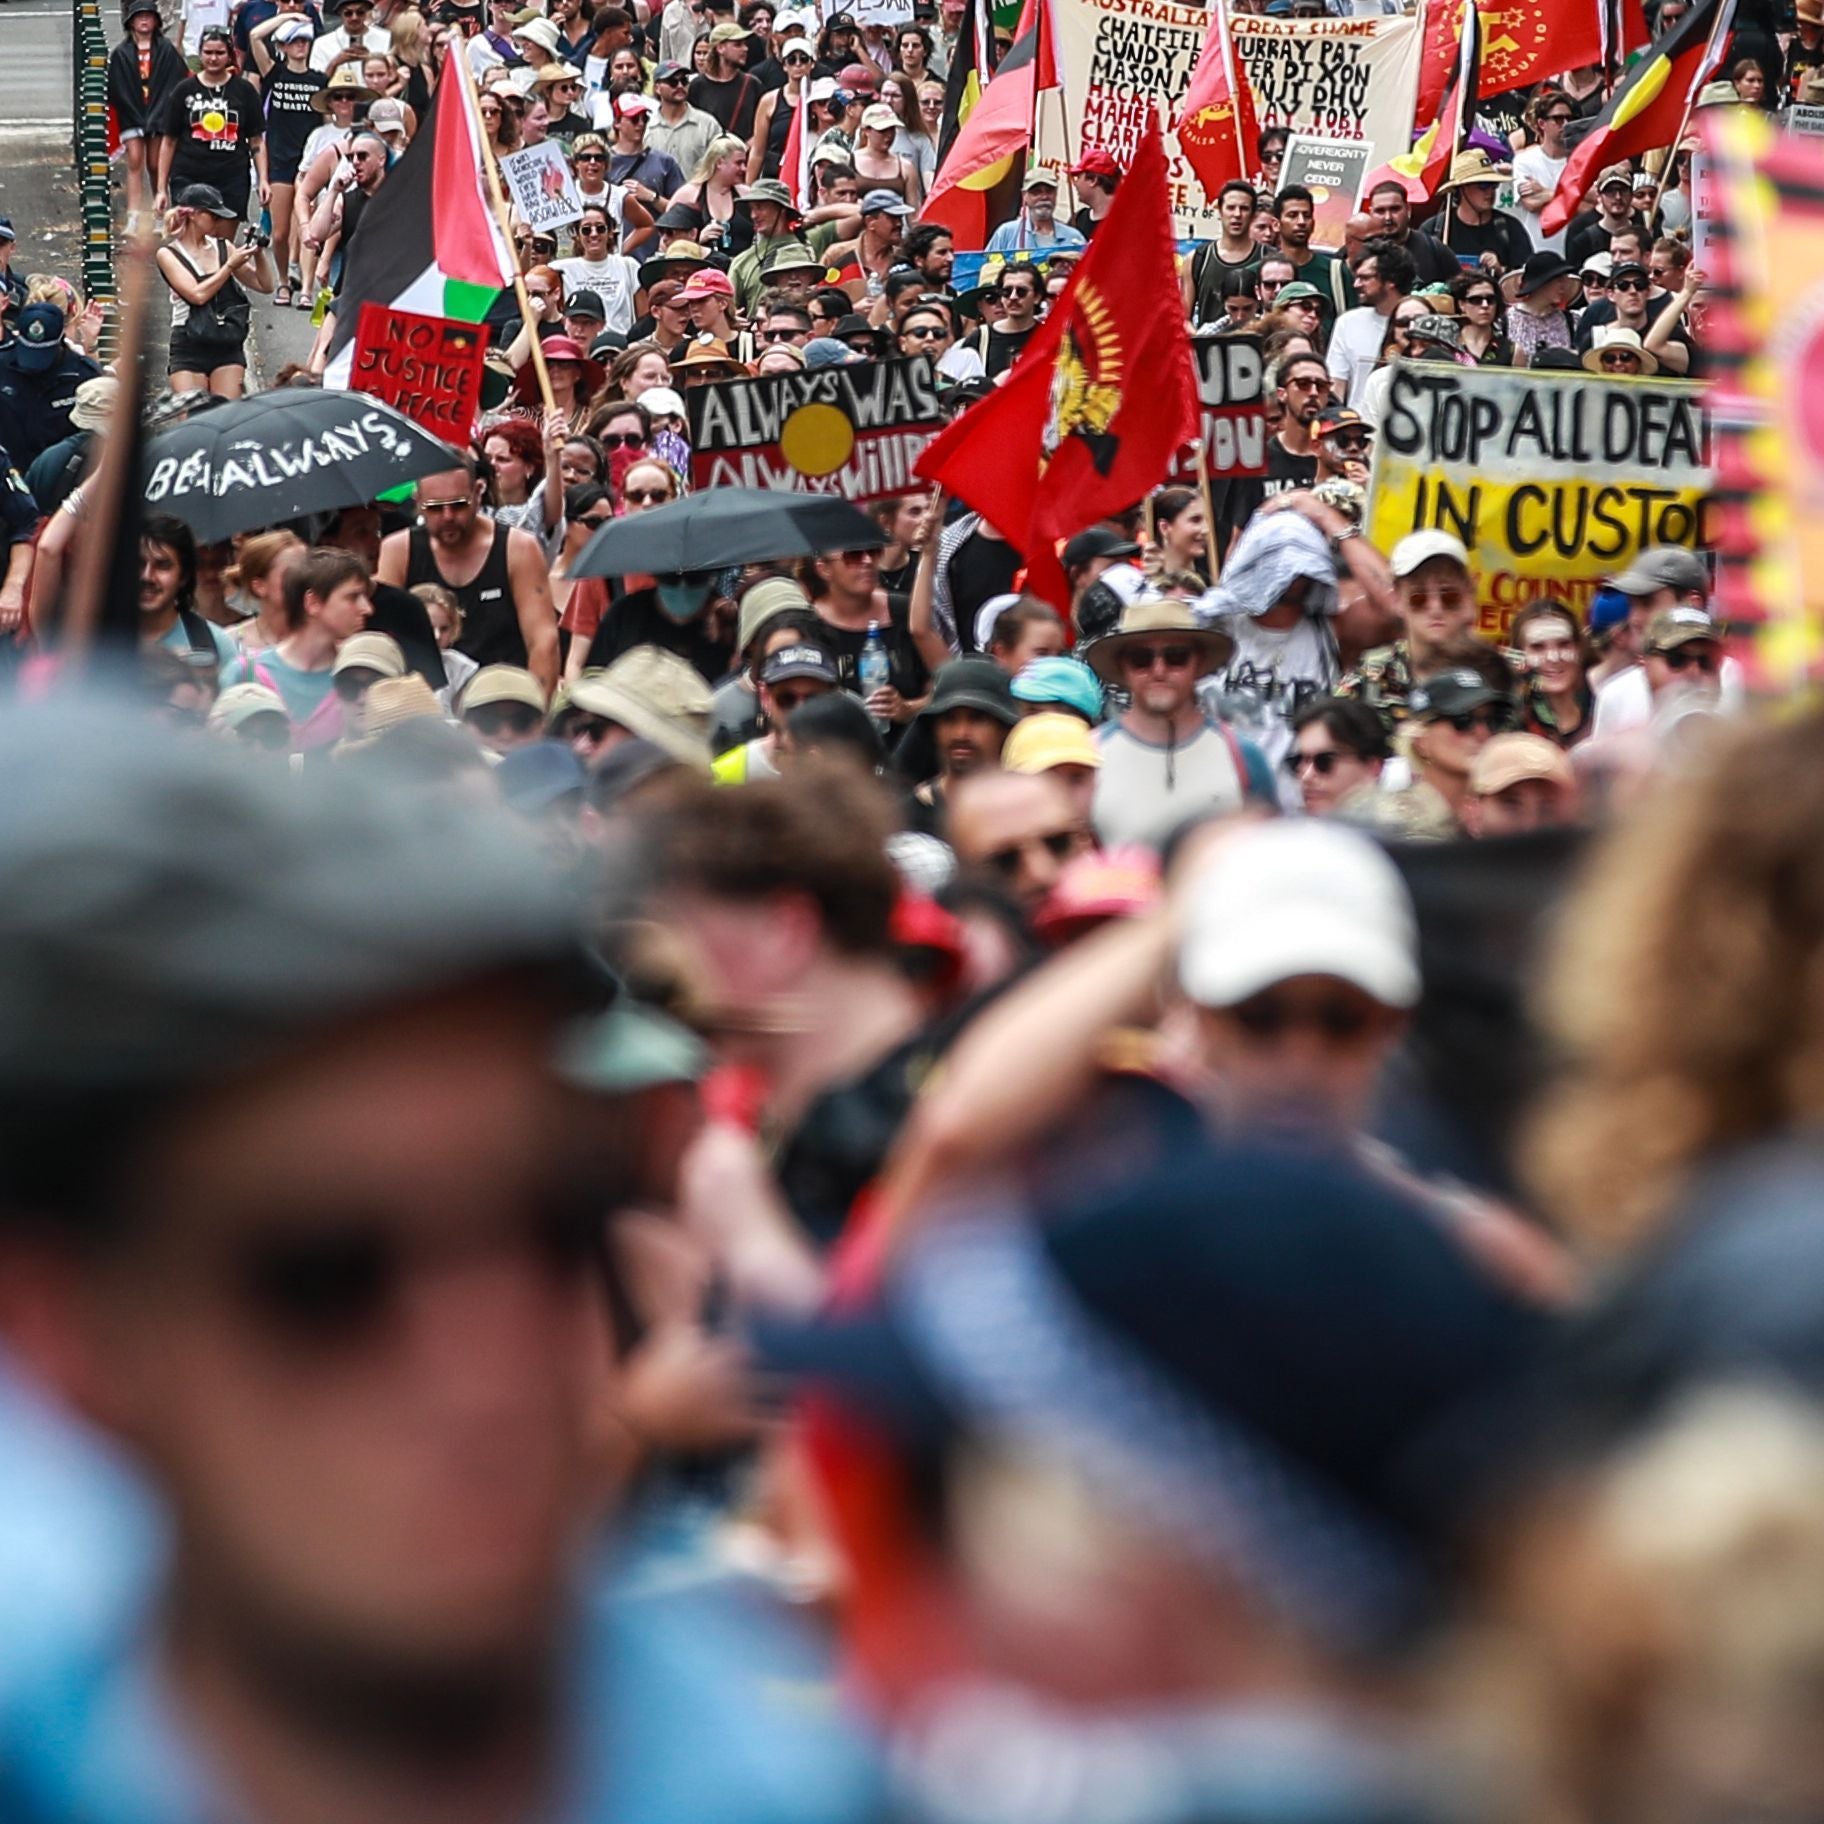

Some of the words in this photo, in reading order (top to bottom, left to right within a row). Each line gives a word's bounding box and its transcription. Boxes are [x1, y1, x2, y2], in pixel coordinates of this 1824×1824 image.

[1094, 35, 1180, 67] CUNDY
[1283, 60, 1372, 87] DIXON
[1098, 14, 1204, 53] CHATFIEL
[1320, 42, 1364, 64] PAT
[1090, 54, 1175, 90] MASON
[1312, 82, 1366, 108] DHU
[1310, 105, 1370, 130] TOBY
[1303, 174, 1342, 187] CEDED
[1306, 160, 1345, 174] NEVER
[386, 317, 435, 349] NO
[359, 346, 471, 396] JUSTICE
[393, 390, 464, 425] PEACE
[697, 369, 840, 451] ALWAYS
[841, 355, 942, 429] WAS
[1383, 373, 1503, 462] STOP
[1506, 388, 1594, 464] ALL
[1412, 472, 1481, 550] IN
